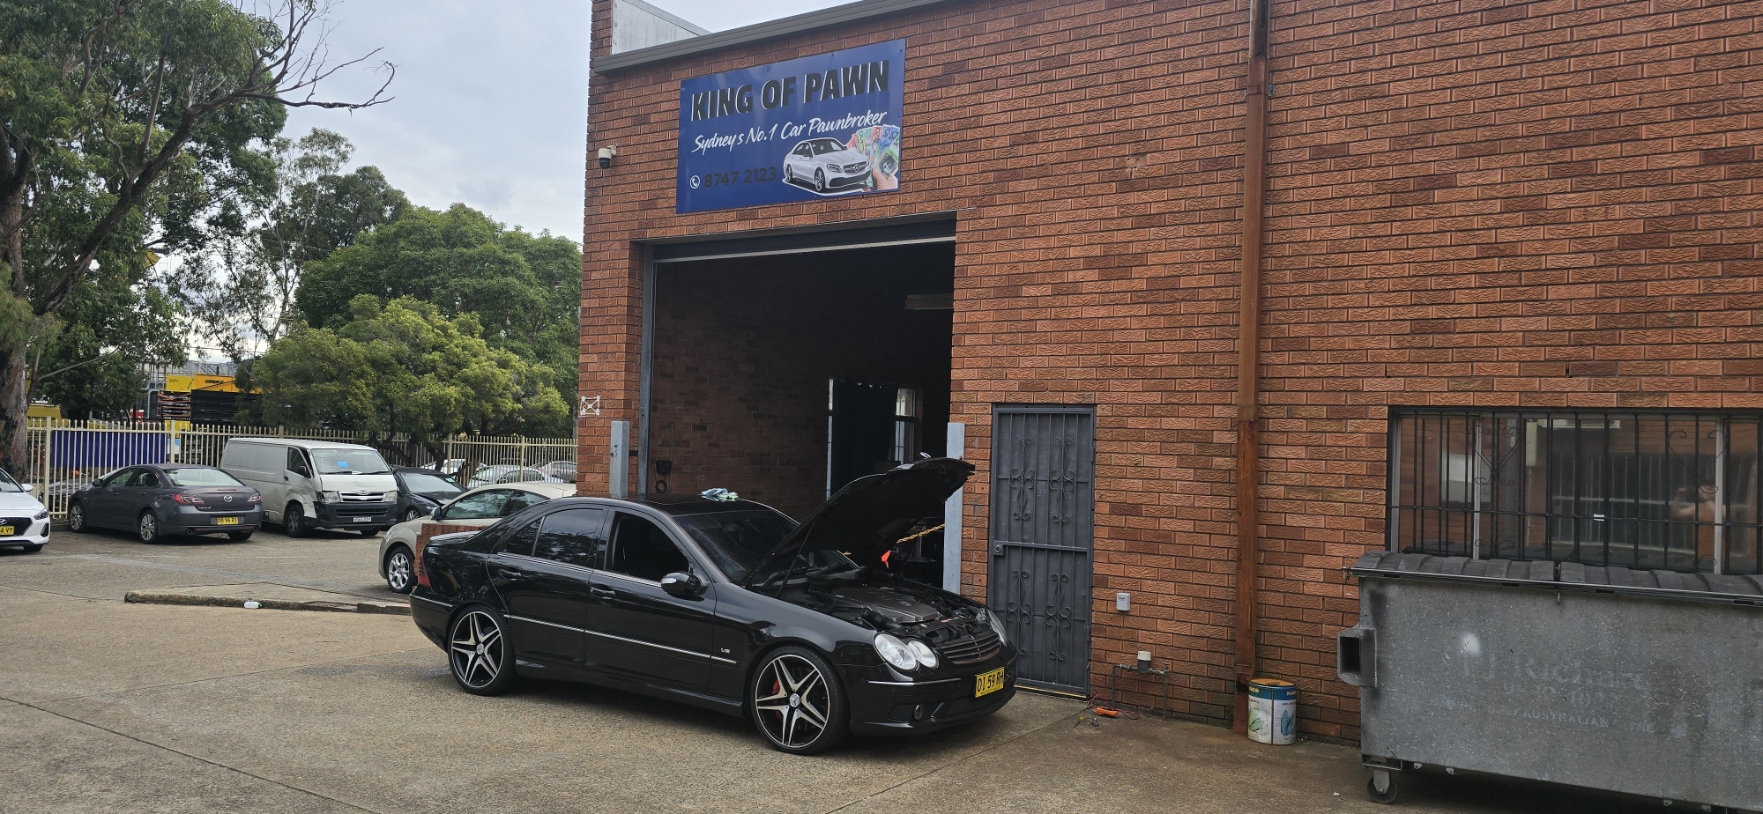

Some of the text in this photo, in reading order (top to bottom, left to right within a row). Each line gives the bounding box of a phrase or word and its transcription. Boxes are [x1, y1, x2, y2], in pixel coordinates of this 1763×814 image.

[691, 60, 889, 122] KING OF PAWN
[780, 121, 807, 140] Car
[808, 109, 888, 136] Pawnbroker
[703, 166, 777, 188] 8747 2123
